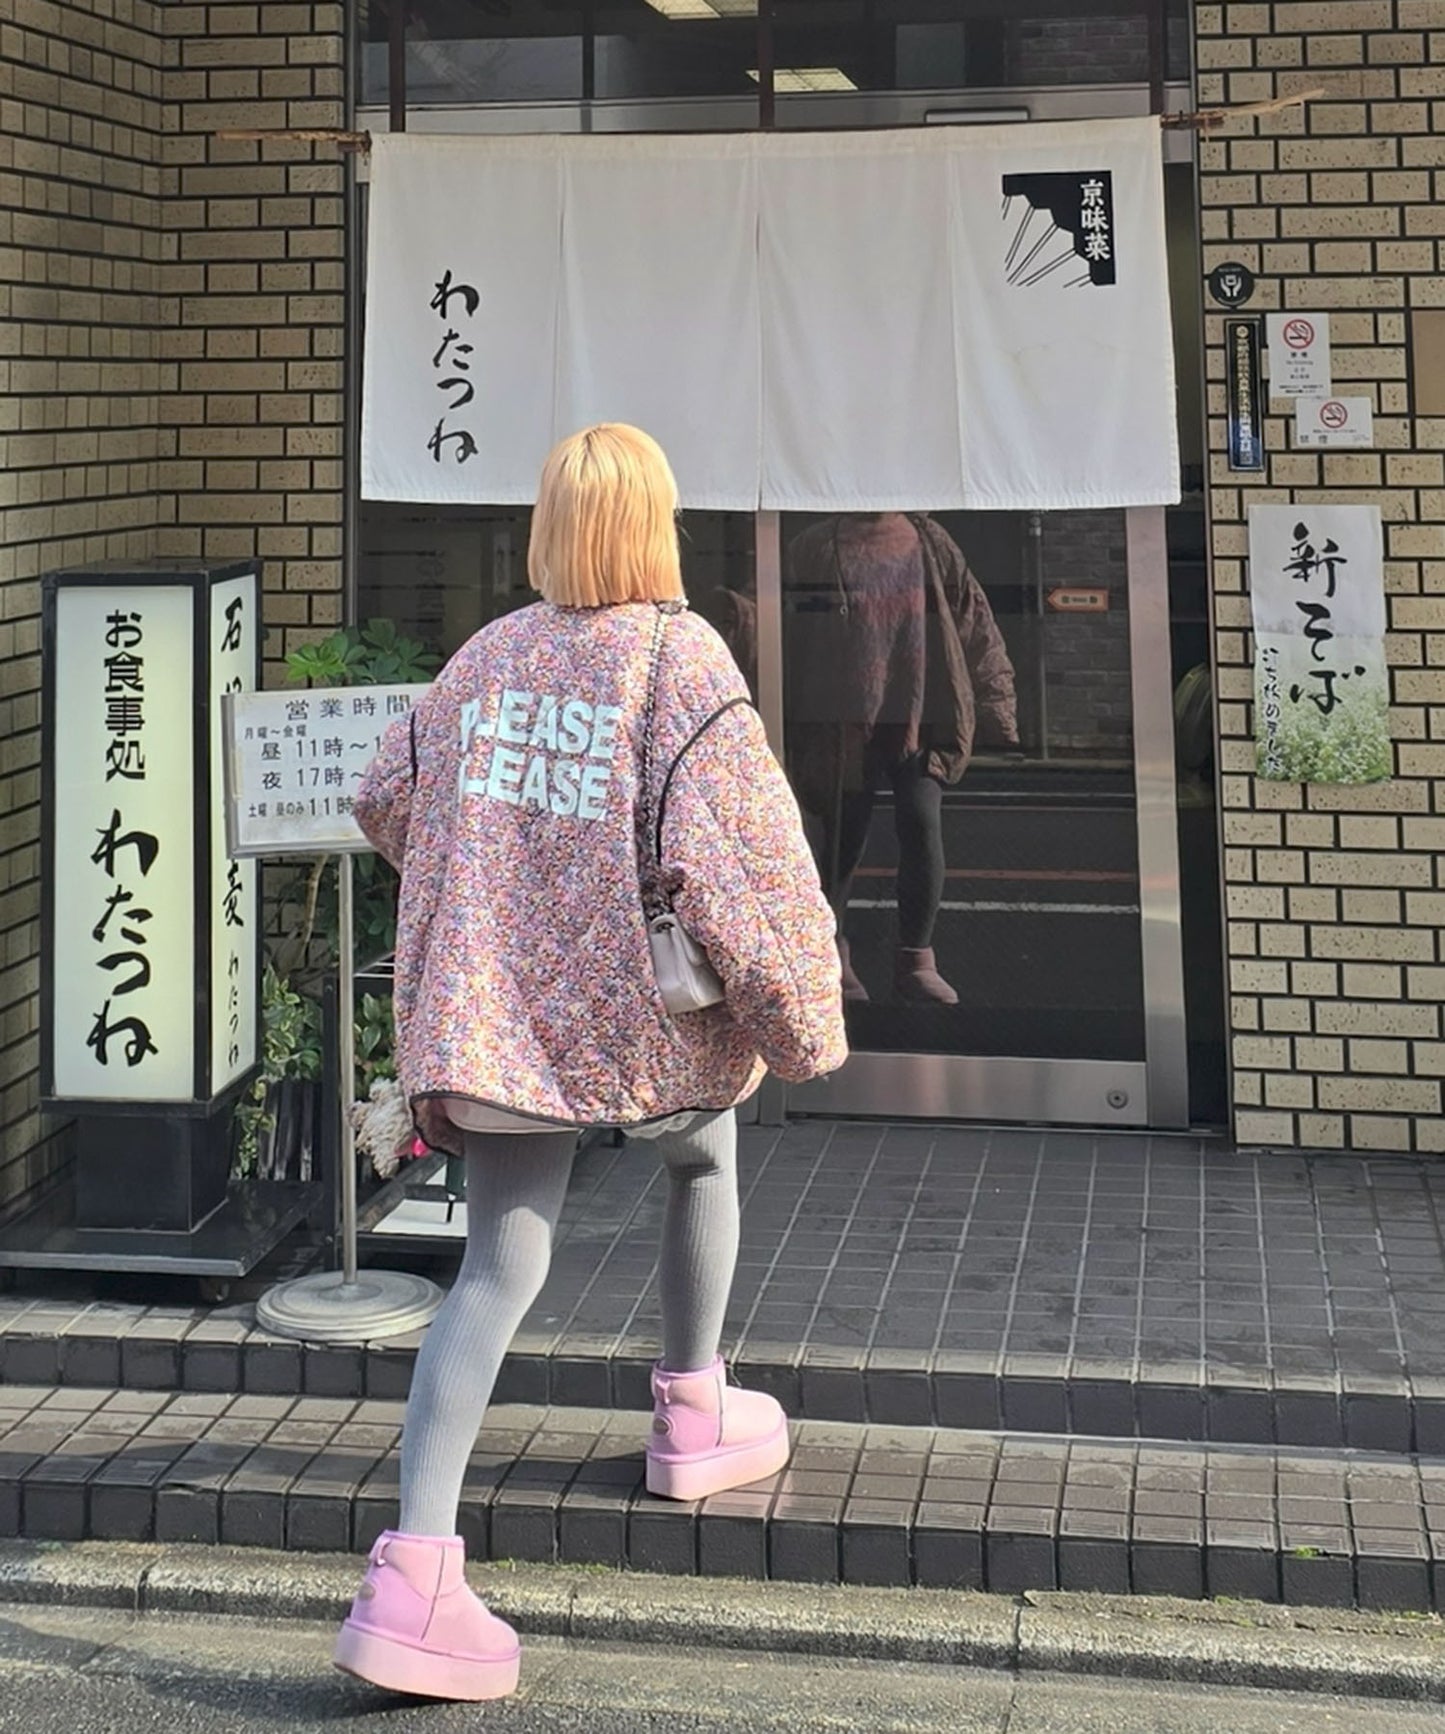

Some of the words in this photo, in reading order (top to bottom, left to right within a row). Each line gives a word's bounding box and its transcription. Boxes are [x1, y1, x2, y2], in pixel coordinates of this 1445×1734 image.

[1080, 179, 1111, 261] 京味菜
[427, 269, 480, 464] わたつね
[1282, 521, 1366, 715] 新そば
[104, 609, 146, 783] お食事処
[261, 742, 282, 761] 昼
[285, 694, 411, 721] 営業時間
[262, 771, 282, 790] 夜
[86, 808, 159, 1067] わたつね
[227, 950, 240, 1069] わたつね
